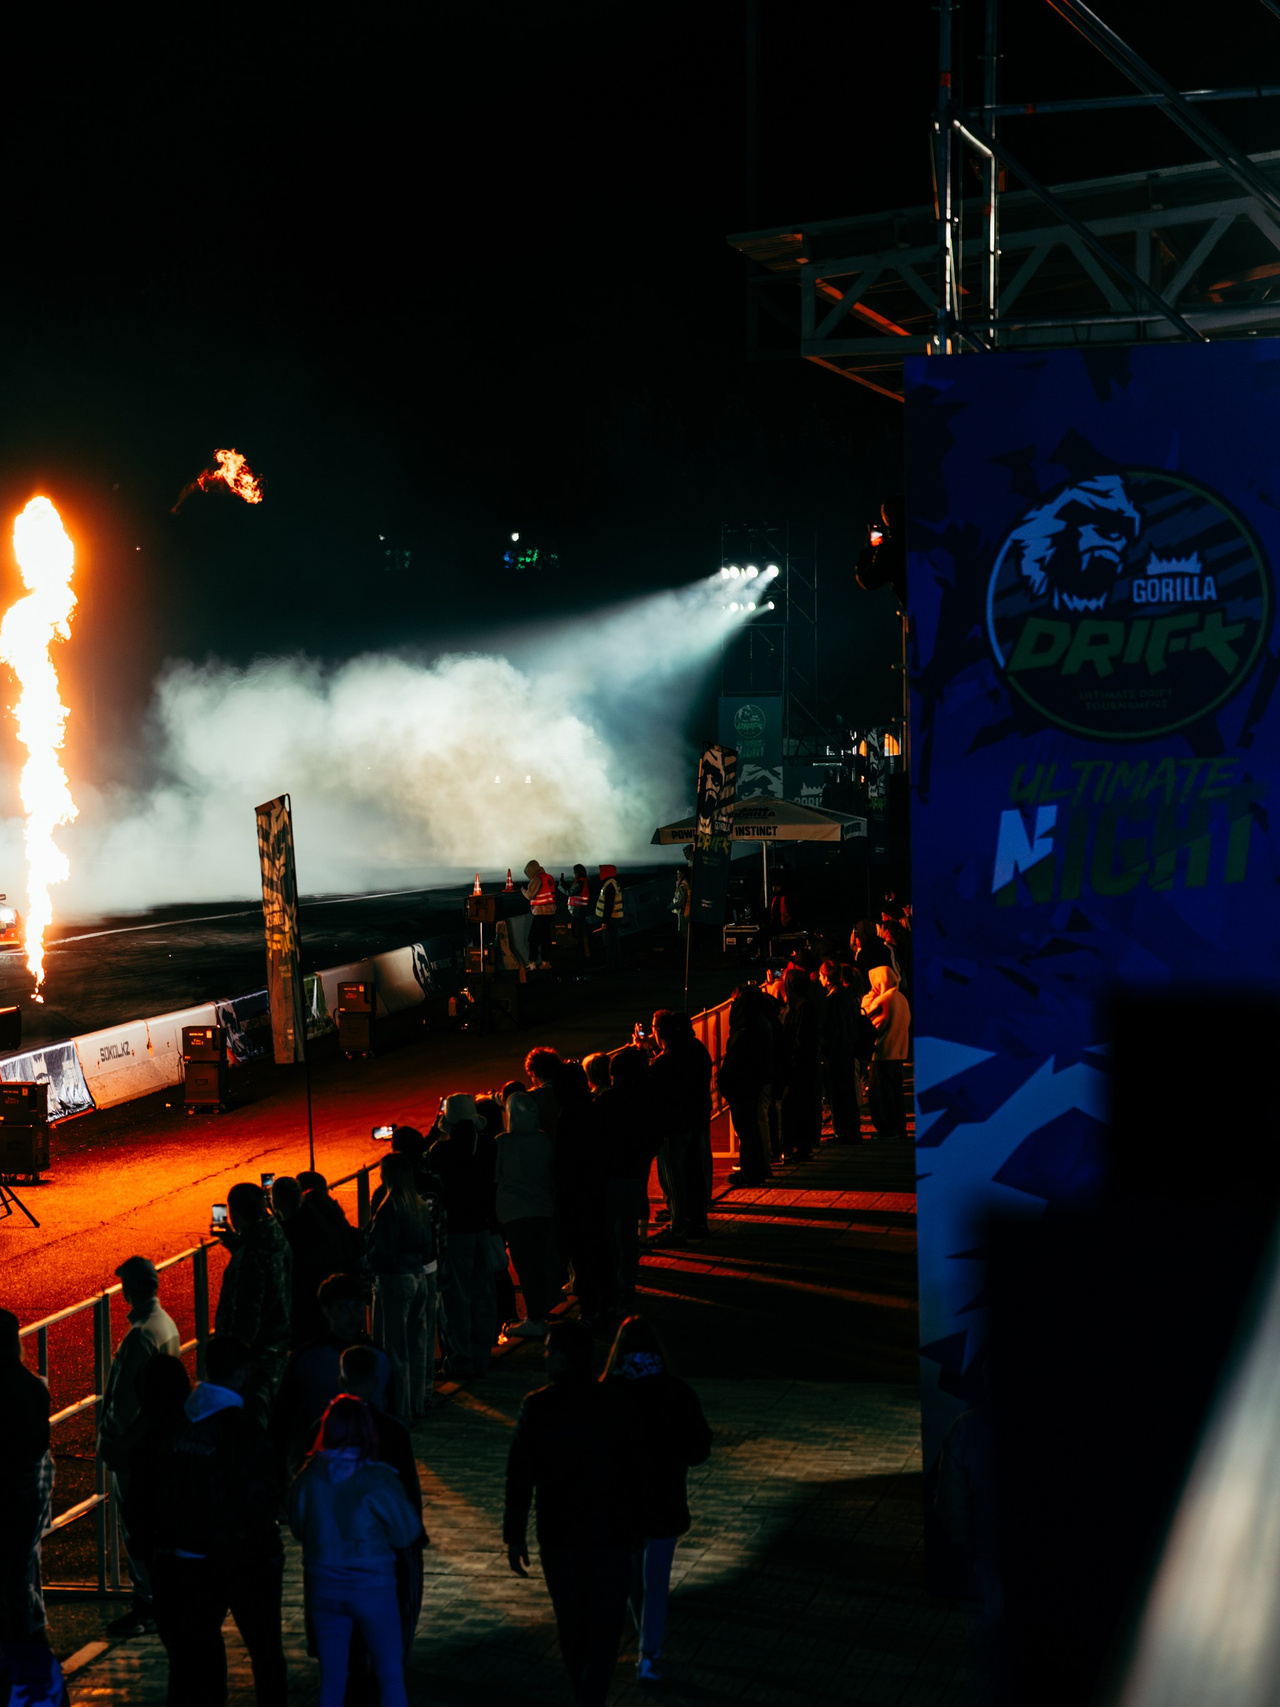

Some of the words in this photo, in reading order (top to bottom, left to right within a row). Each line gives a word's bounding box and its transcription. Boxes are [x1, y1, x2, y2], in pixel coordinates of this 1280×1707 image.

[1132, 576, 1218, 603] GORILLA
[1010, 757, 1240, 806] ULTIMATE
[735, 826, 778, 837] INSTINCT
[991, 782, 1268, 907] NIGHT
